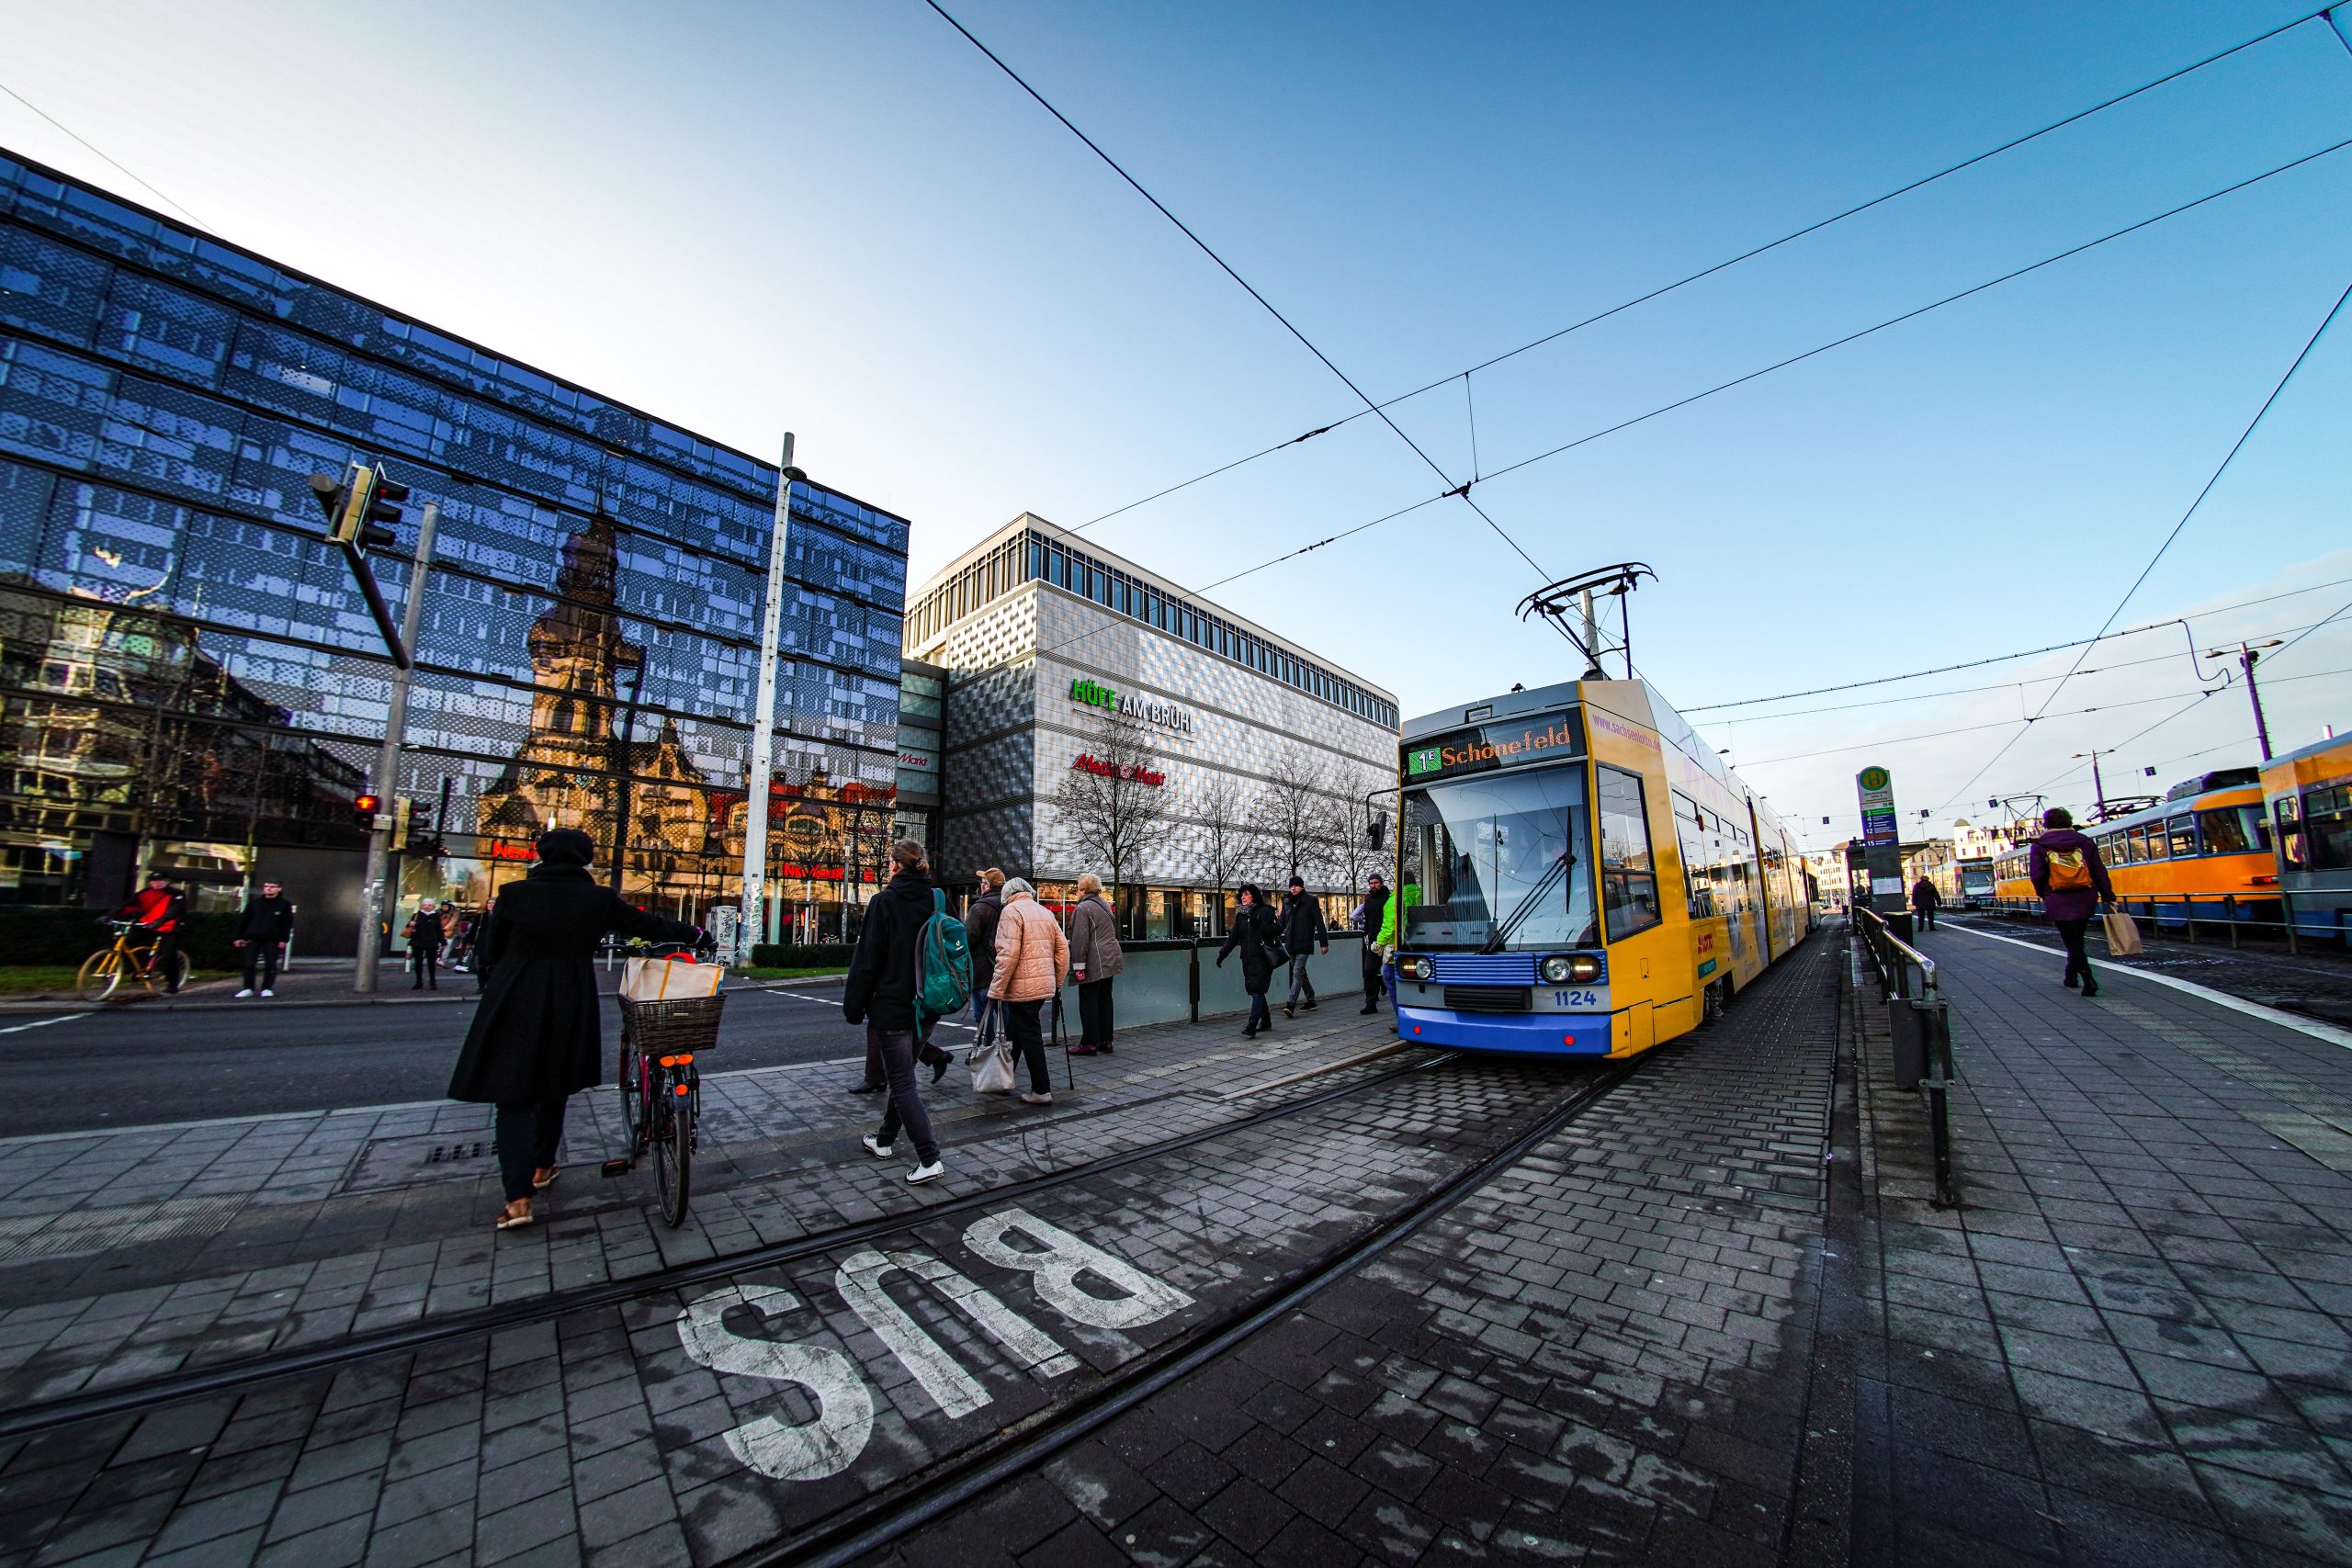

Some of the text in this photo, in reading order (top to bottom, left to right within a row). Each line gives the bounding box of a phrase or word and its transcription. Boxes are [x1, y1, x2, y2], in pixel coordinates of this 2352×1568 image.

[1073, 678, 1194, 734] HÖFE AM BRÜHL
[1442, 721, 1571, 767] Schönefeld
[1592, 713, 1661, 751] www.sachsenlotto.de
[897, 752, 928, 766] Markt
[1134, 764, 1167, 786] Markt
[1555, 990, 1597, 1006] 1124
[676, 1207, 1196, 1482] BUS
